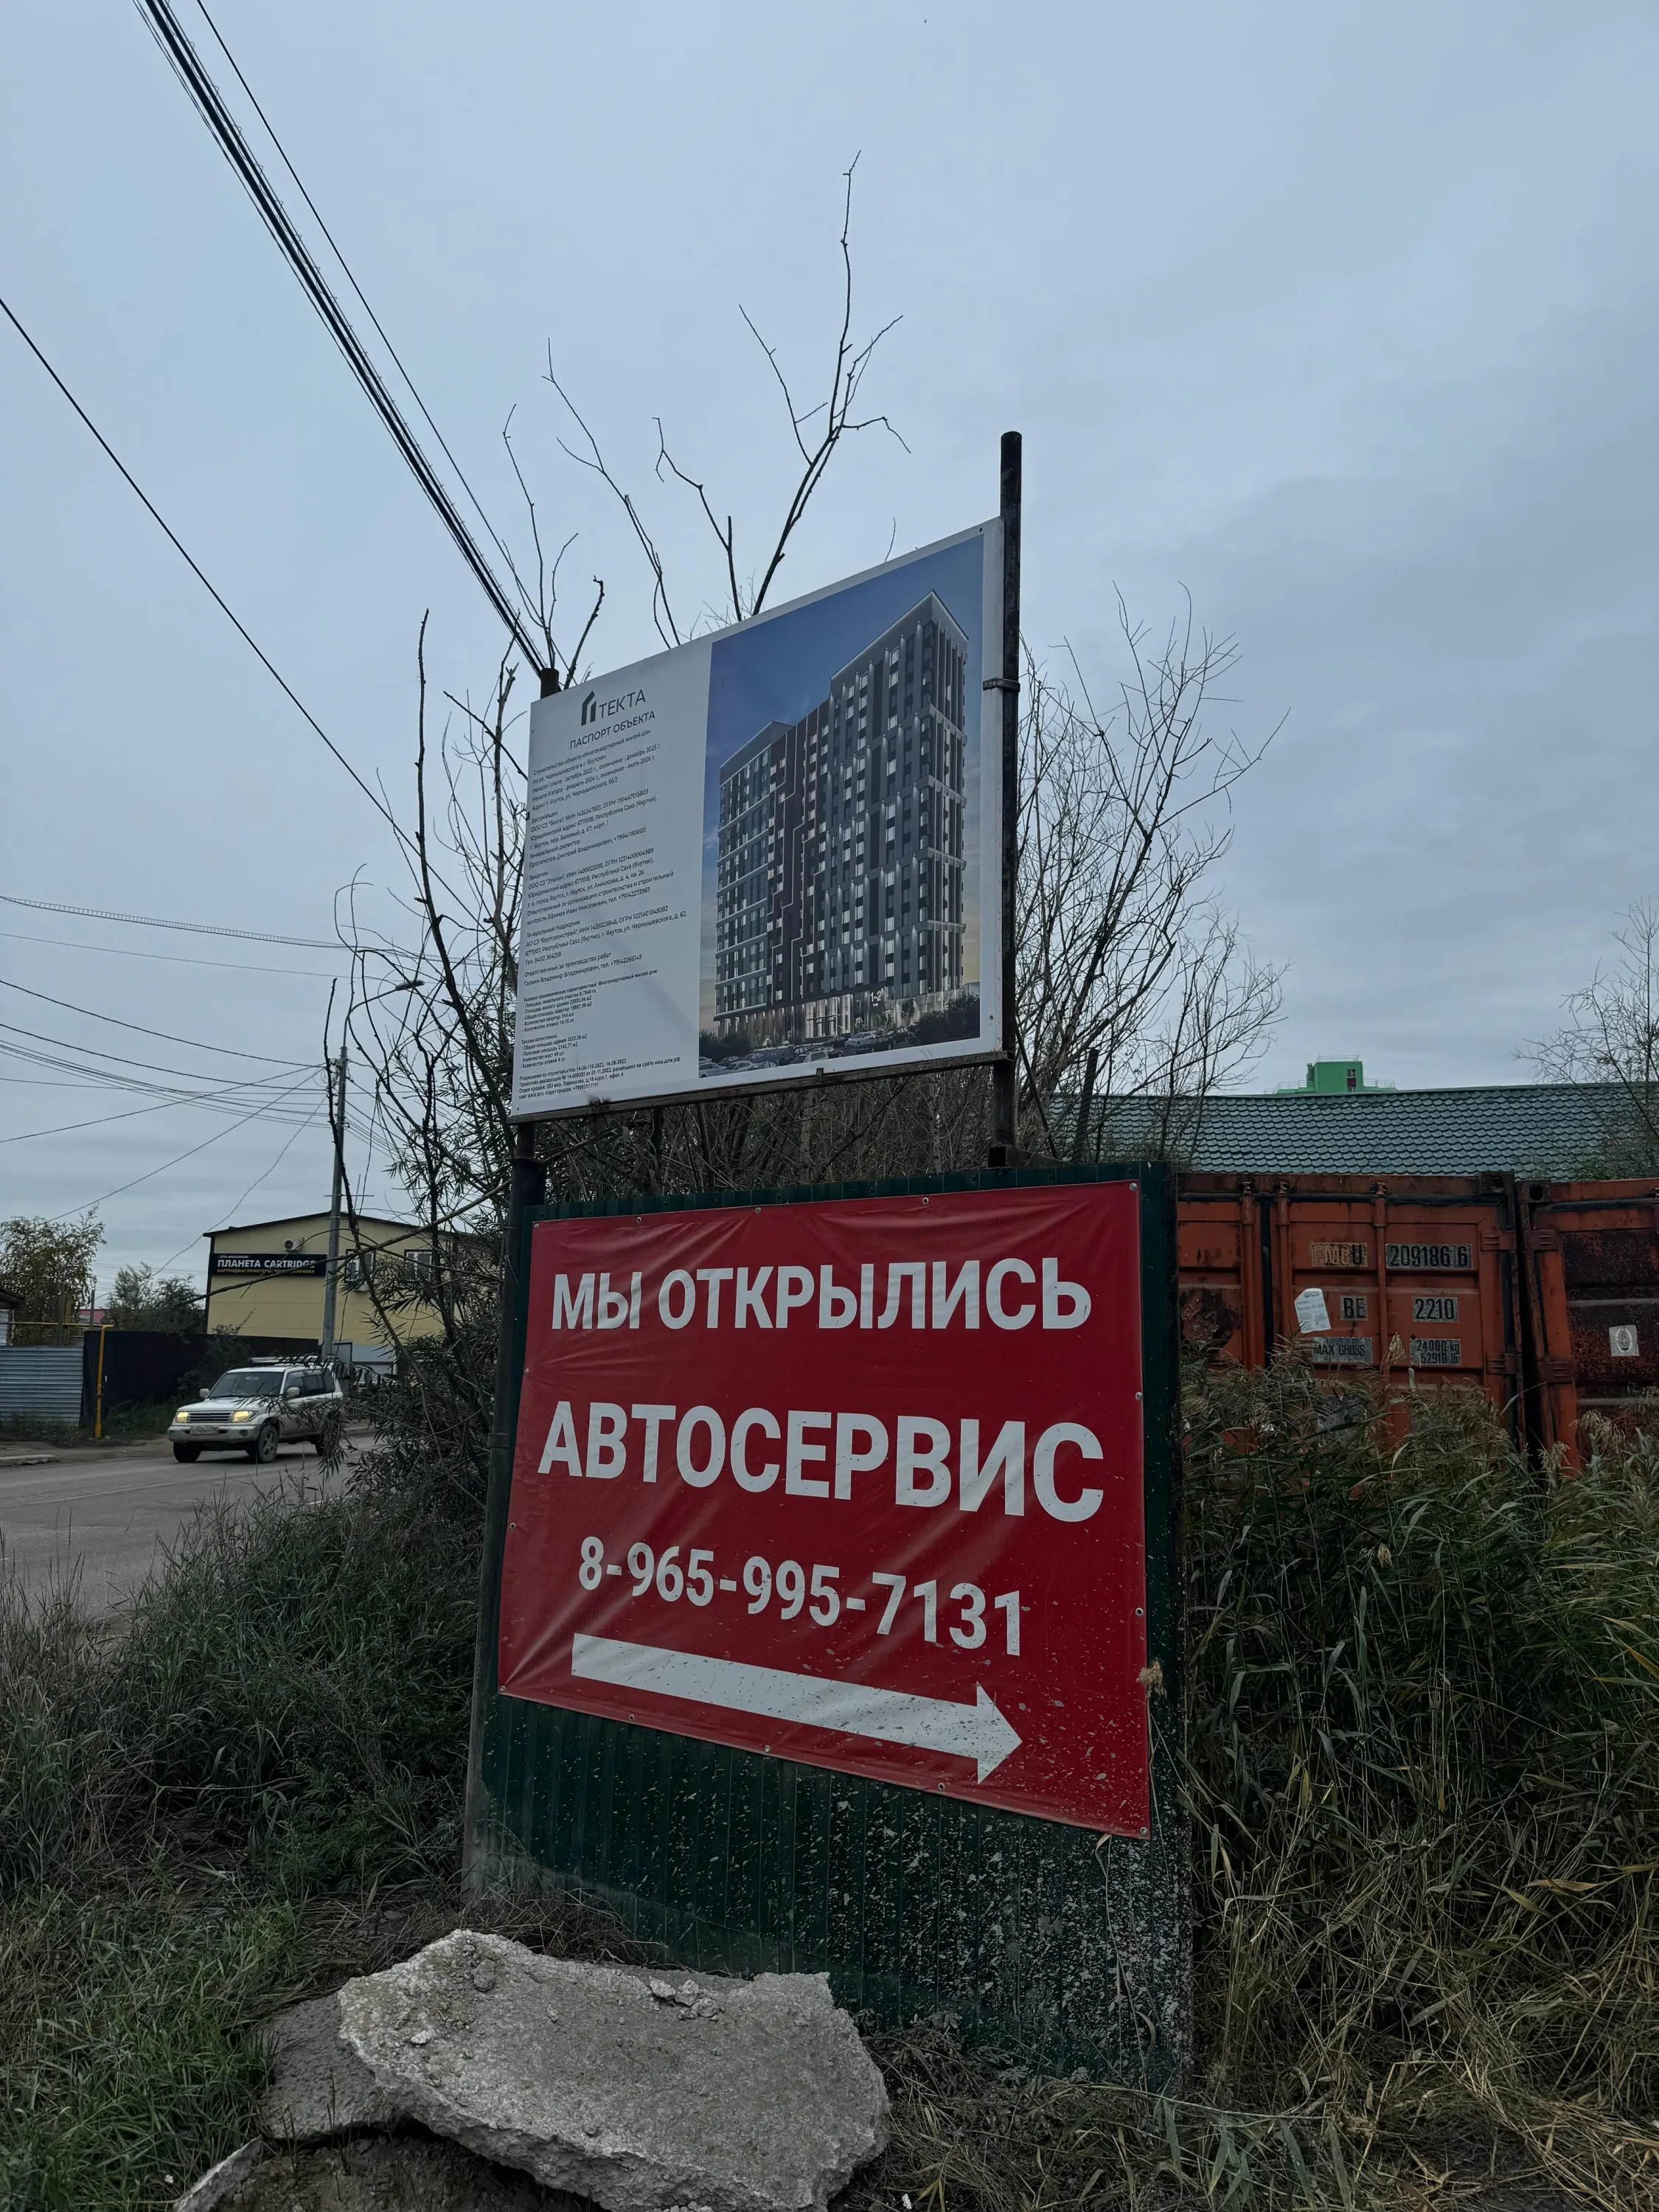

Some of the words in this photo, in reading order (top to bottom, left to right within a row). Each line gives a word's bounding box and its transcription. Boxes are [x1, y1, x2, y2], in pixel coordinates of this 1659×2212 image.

[599, 689, 646, 719] ТЕКТА
[569, 726, 611, 750] ПАСПОРТ
[613, 710, 655, 732] ОБЪЕКТА
[533, 761, 564, 776] Строительство
[564, 754, 582, 765] объекта
[625, 731, 641, 742] жилой
[641, 729, 650, 737] дом
[532, 784, 548, 793] Начало
[550, 779, 563, 787] этапа
[565, 772, 582, 782] октябрь
[599, 757, 623, 770] окончание
[626, 750, 645, 761] декабрь
[532, 793, 548, 802] Начало
[551, 787, 563, 796] этапа
[566, 781, 585, 790] февраль
[600, 766, 625, 779] окончание
[545, 764, 580, 779] Чернышевского
[571, 781, 608, 796] Чернышевского,
[530, 824, 542, 832] ООО
[577, 804, 602, 817] 1435347923,
[602, 799, 616, 808] ОГРН
[616, 788, 649, 804] 1191447015803
[531, 811, 558, 824] Застройщик
[530, 826, 562, 841] Юридический
[595, 807, 623, 820] Республика
[560, 829, 581, 841] Базовый,
[529, 845, 559, 859] Генеральный
[558, 839, 581, 850] директор
[556, 848, 577, 860] Дмитрий
[577, 838, 613, 853] Владимирович,
[528, 881, 539, 889] ООО
[566, 870, 577, 878] ИНН
[577, 862, 604, 874] 1400022018,
[604, 858, 618, 867] ОГРН
[618, 847, 654, 863] 1231400004989
[529, 872, 549, 881] Заказчик
[527, 902, 561, 917] Ответственный
[567, 893, 598, 905] организацию
[598, 883, 633, 897] строительства
[637, 870, 674, 886] строительный
[528, 884, 560, 899] Юридический
[591, 868, 619, 880] Республика
[526, 917, 547, 925] контроль
[578, 900, 608, 911] Николаевич,
[579, 925, 590, 933] ИНН
[591, 918, 618, 931] 1435023848,
[619, 915, 633, 923] ОГРН
[633, 905, 669, 919] 1021401045082
[526, 925, 555, 938] Генеральный
[555, 919, 580, 931] подрядчик
[542, 941, 568, 952] Республика
[631, 915, 673, 929] Чернышевского,
[524, 964, 558, 977] Ответственный
[564, 956, 597, 969] производство
[597, 952, 611, 961] работ
[540, 973, 563, 983] Владимир
[563, 965, 600, 977] Владимирович,
[218, 1259, 262, 1267] ПЛАНЕТА
[1390, 1245, 1451, 1267] 209186
[1457, 1246, 1468, 1267] 6
[552, 1272, 642, 1330] МЫ
[658, 1257, 1093, 1330] ОТКРЫЛИСЬ
[1343, 1297, 1366, 1318] BE
[1415, 1298, 1455, 1320] 2210
[1313, 1344, 1335, 1356] MAX
[1338, 1344, 1366, 1356] GROSS
[1416, 1340, 1447, 1352] 24000
[1450, 1340, 1461, 1354] kg
[1421, 1352, 1447, 1364] 52910
[538, 1400, 1105, 1523] АВТОСЕРВИС
[579, 1536, 1021, 1657] 8-965-995-7131
